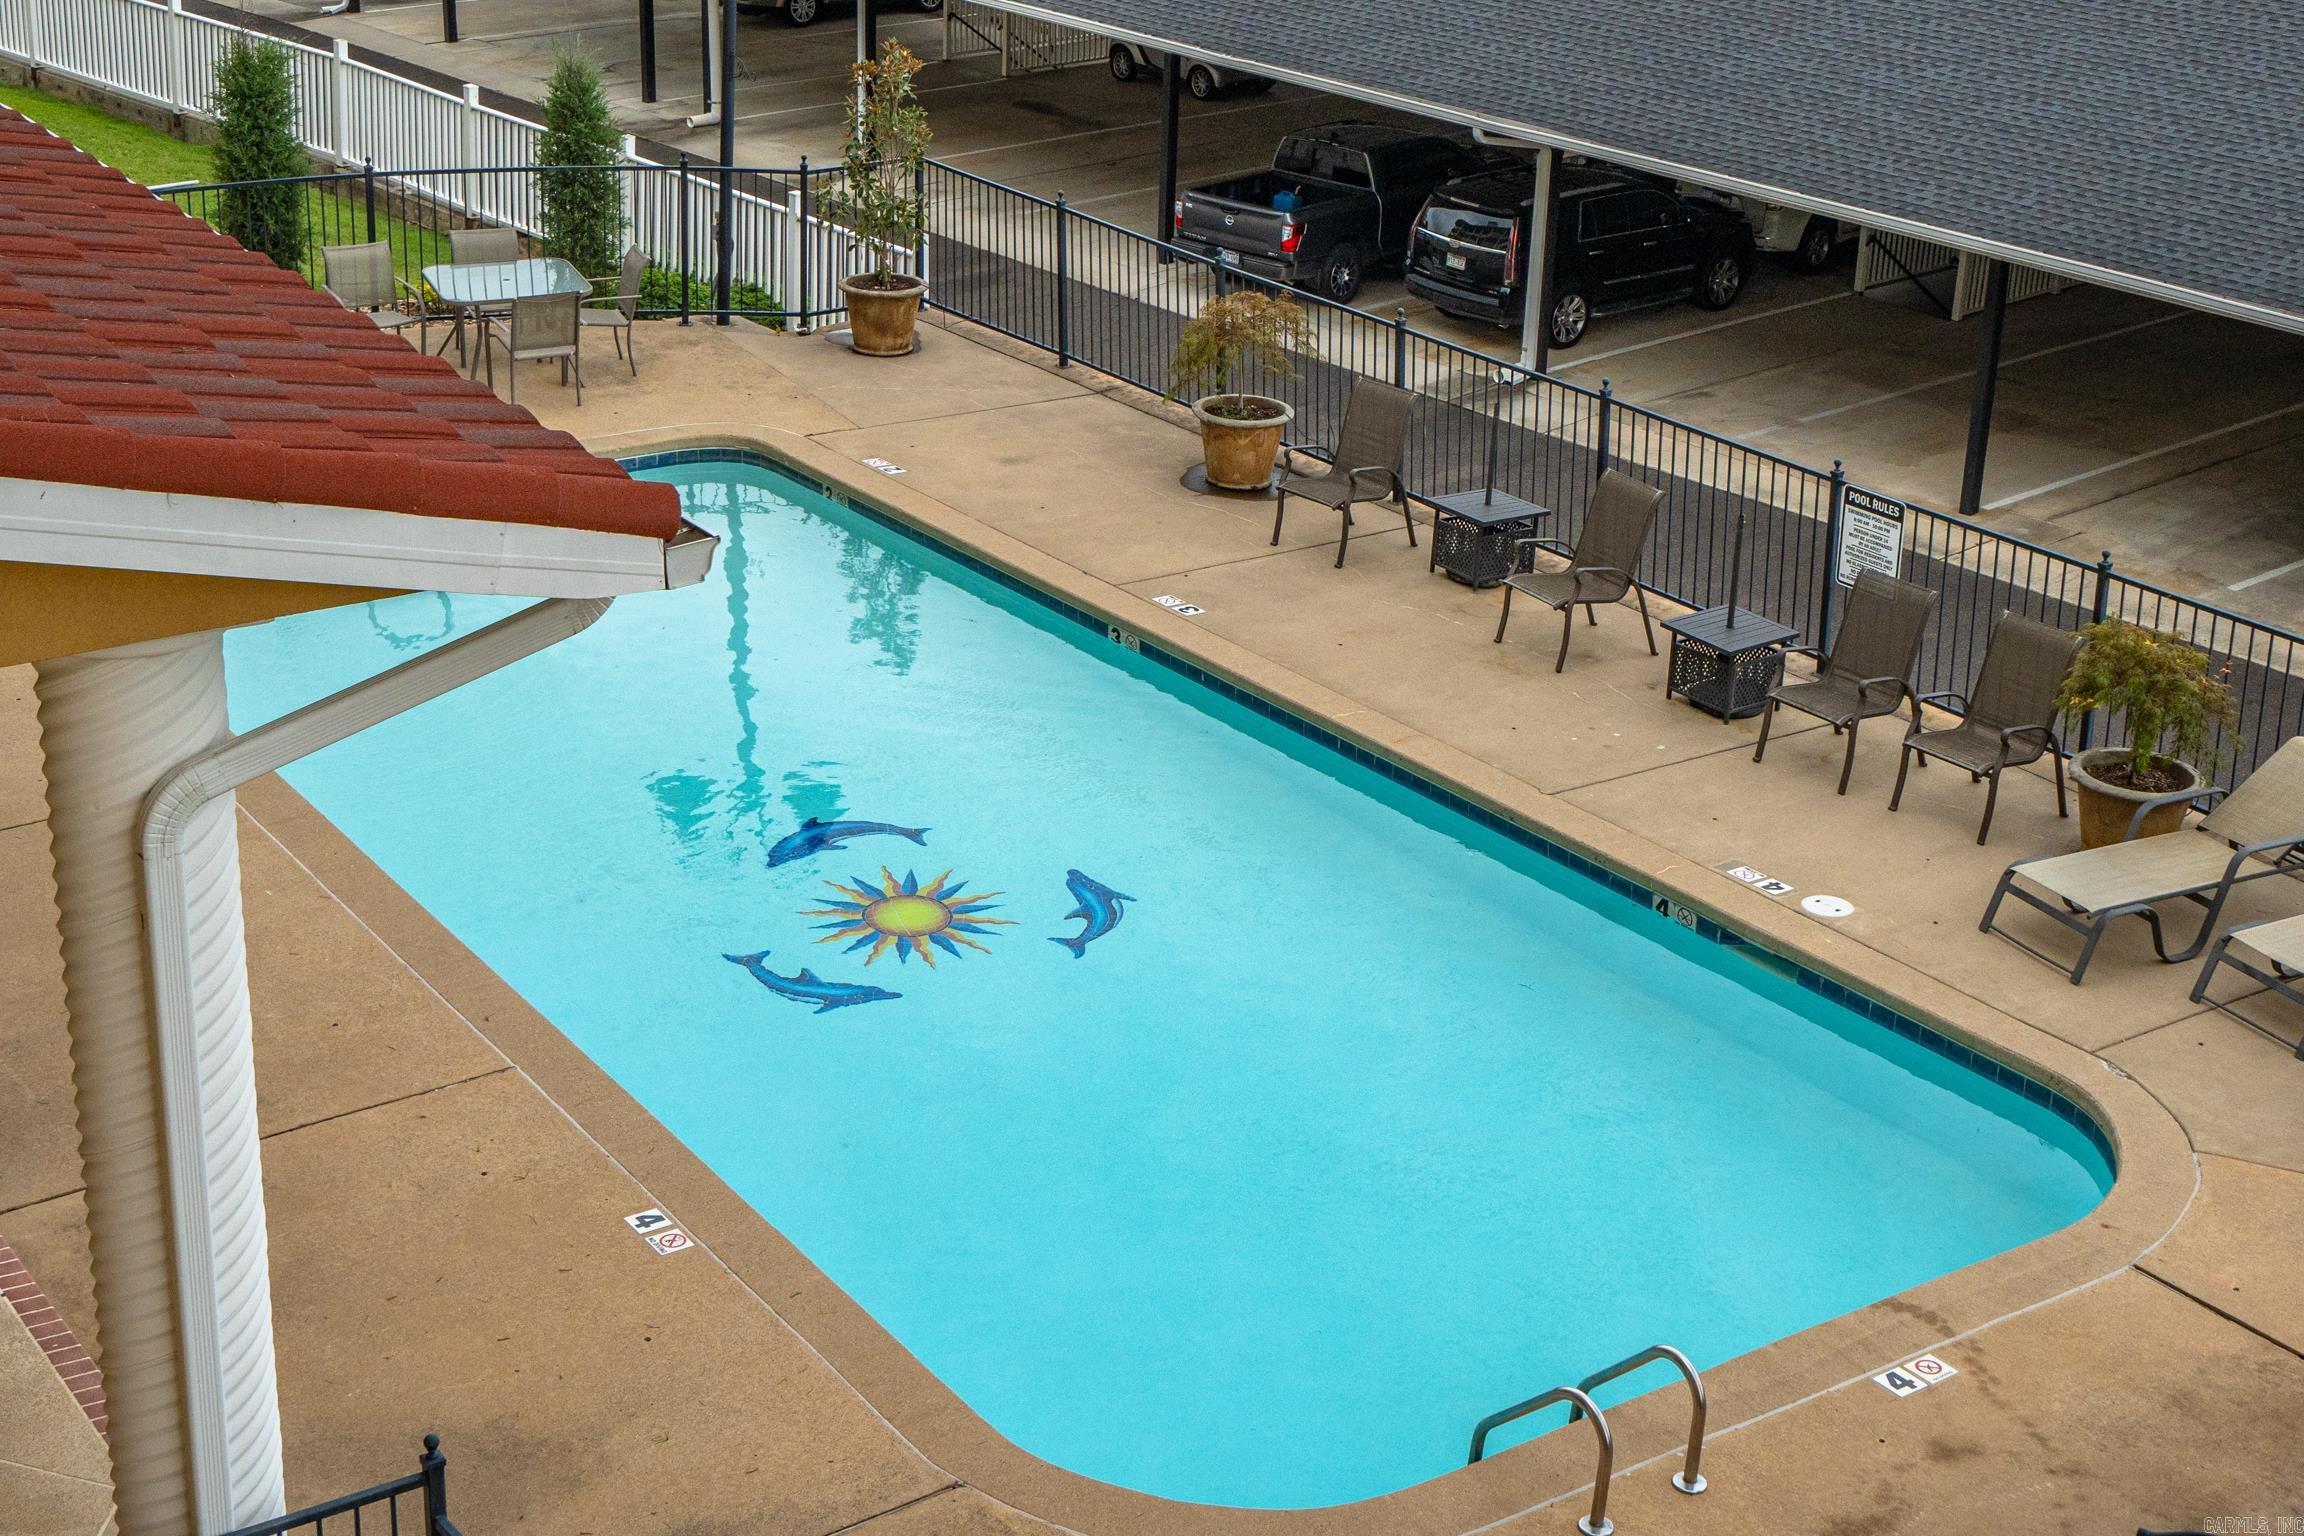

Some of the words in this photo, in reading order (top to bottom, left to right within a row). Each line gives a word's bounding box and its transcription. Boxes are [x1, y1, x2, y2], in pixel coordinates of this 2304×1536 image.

[1849, 491, 1872, 508] POOL
[1872, 498, 1900, 517] RULES
[1872, 516, 1882, 524] POOL
[1111, 627, 1121, 644] 3
[1761, 881, 1784, 891] 4
[1656, 898, 1670, 918] 4
[634, 1214, 666, 1229] 4
[1886, 1371, 1918, 1391] 4
